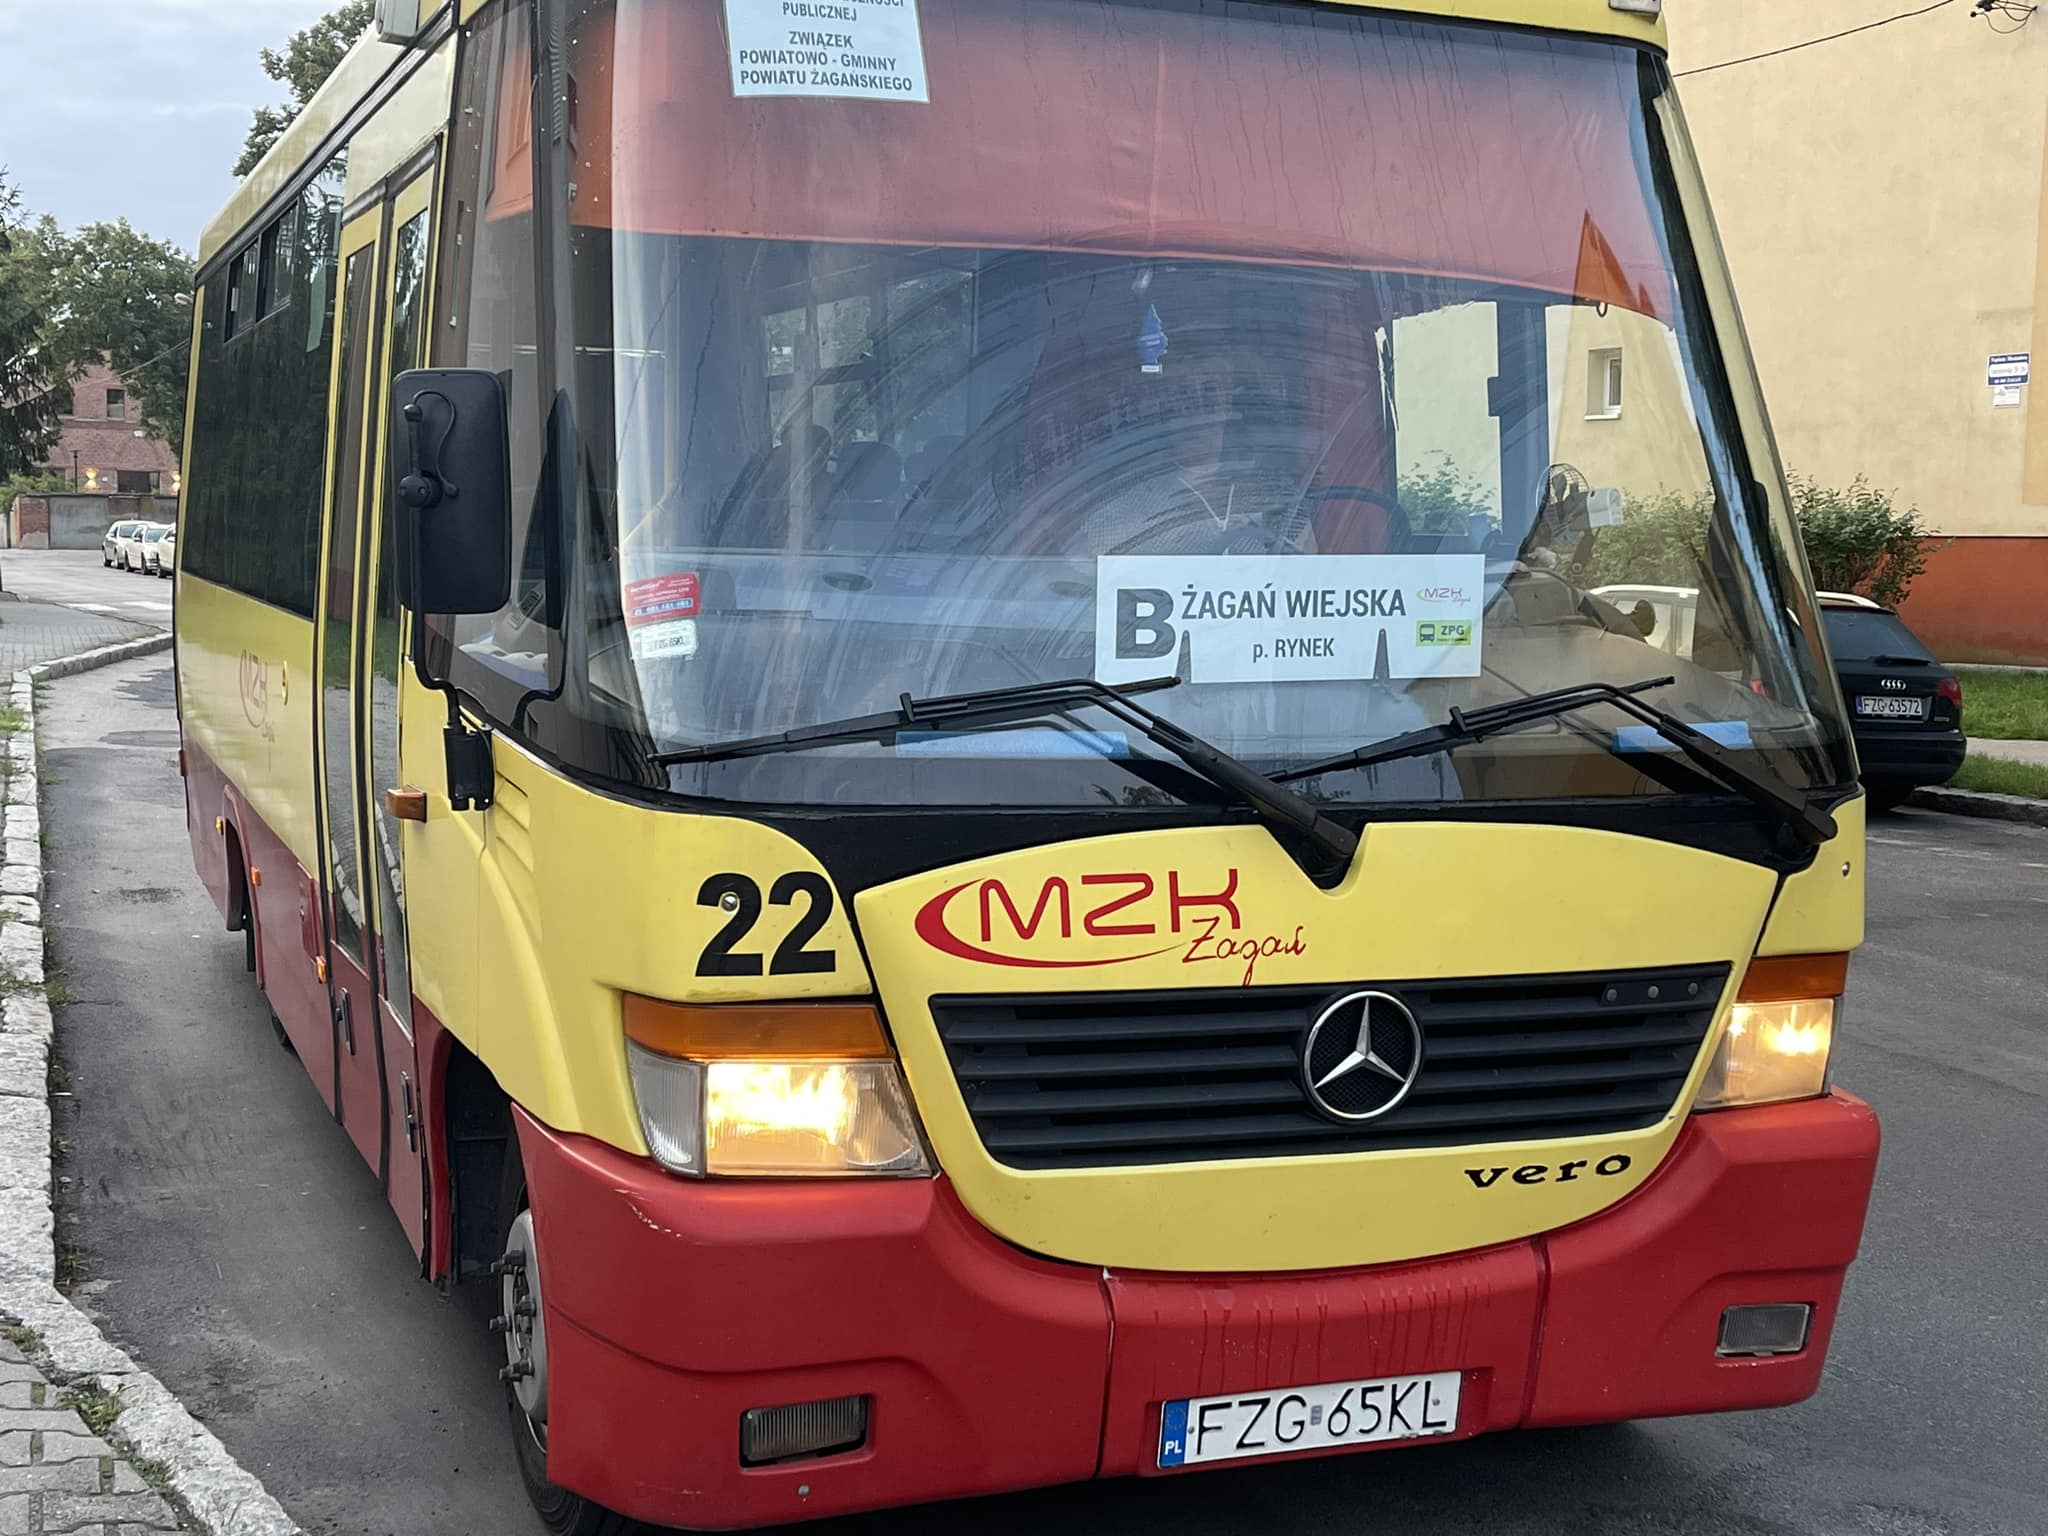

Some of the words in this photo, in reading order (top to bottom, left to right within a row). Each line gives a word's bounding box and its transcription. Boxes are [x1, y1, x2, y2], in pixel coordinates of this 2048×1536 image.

[783, 2, 857, 21] PUBLICZNEJ
[789, 31, 853, 49] ZWIĄZEK
[740, 50, 828, 66] POWIATOWO
[841, 55, 896, 71] GMINNY
[741, 69, 806, 85] POWIATU
[811, 68, 912, 91] ŻAGAŃSKIEGO
[1181, 583, 1276, 620] ŻAGAŃ
[1285, 589, 1406, 618] WIEJSKA
[1115, 588, 1176, 659] B
[1440, 625, 1465, 636] ZPG
[1253, 643, 1269, 664] p.
[1275, 638, 1335, 658] RYNEK
[1863, 697, 1886, 713] FZG
[1889, 698, 1921, 714] 63572
[980, 869, 1240, 942] MZK
[695, 872, 836, 977] 22
[1464, 1154, 1632, 1188] vero
[1164, 1441, 1182, 1455] PL
[1196, 1394, 1307, 1455] FZG
[1328, 1380, 1448, 1437] 65KL
